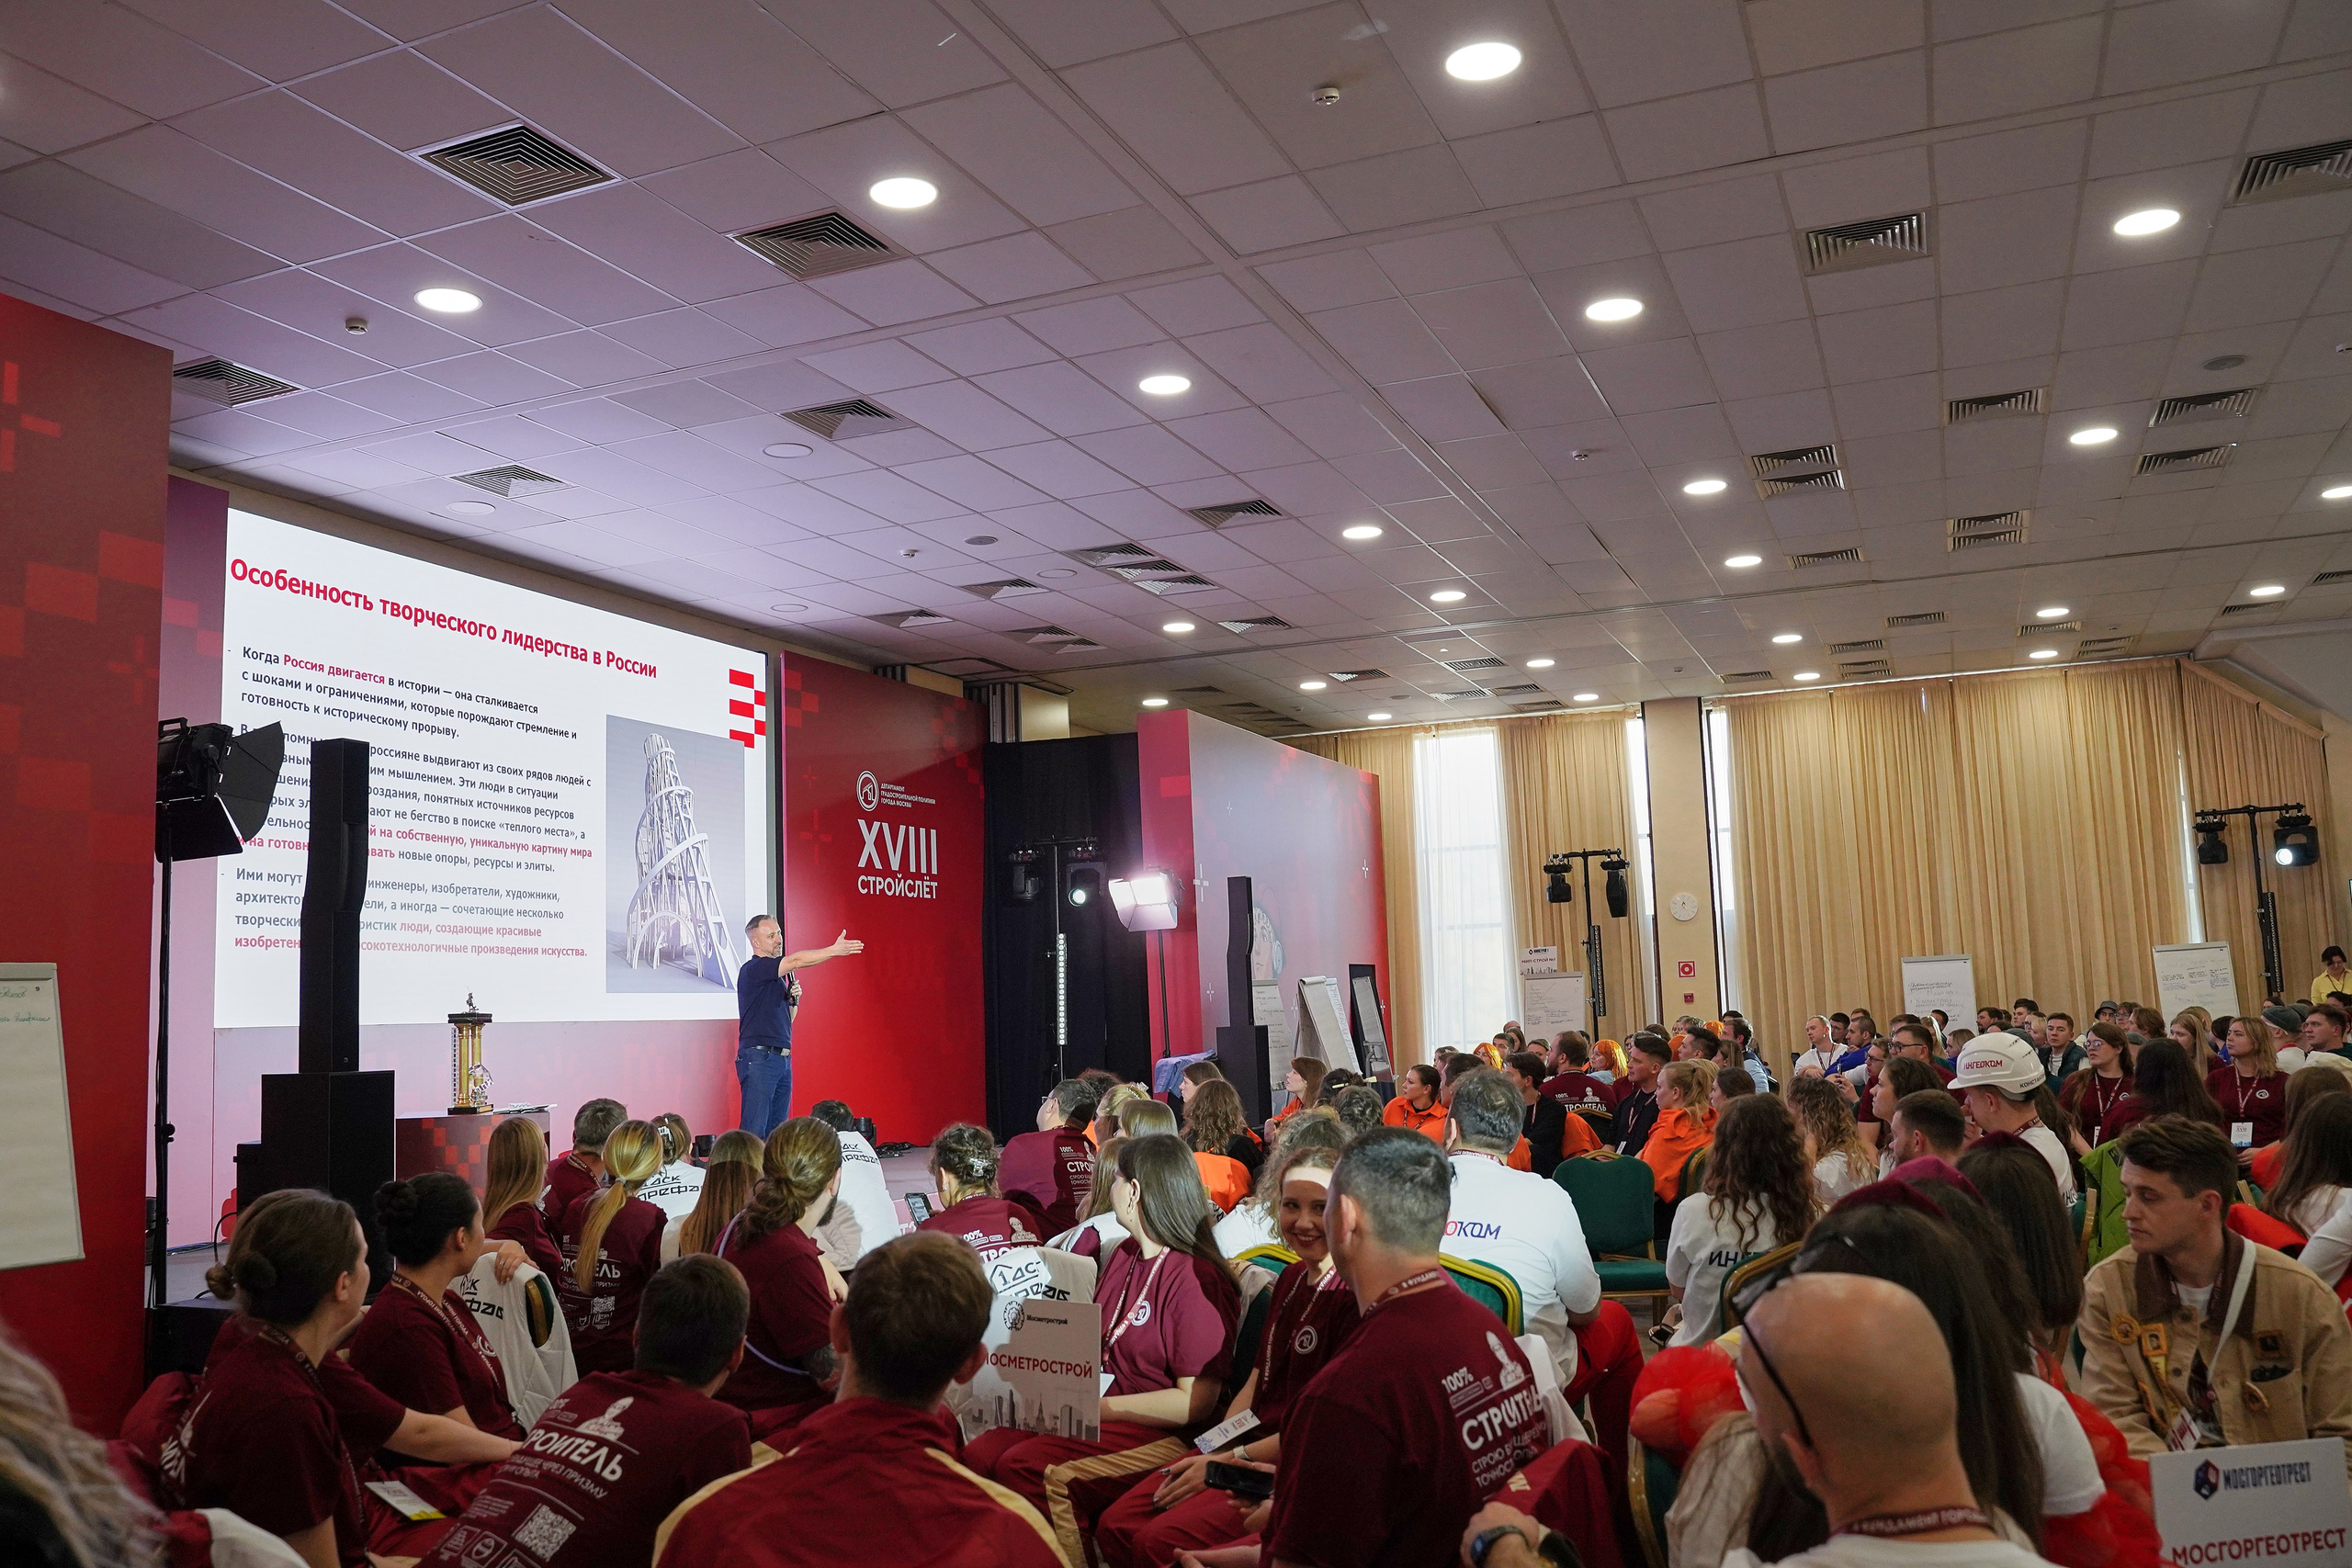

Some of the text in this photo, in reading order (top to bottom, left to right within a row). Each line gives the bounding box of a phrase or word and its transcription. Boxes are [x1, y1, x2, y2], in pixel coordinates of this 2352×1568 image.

[231, 558, 657, 678] Особенность творческого лидерства в России
[243, 647, 279, 665] Когда
[284, 654, 324, 672] Россия
[328, 666, 385, 684] двигается
[389, 678, 394, 686] в
[398, 680, 440, 694] истории
[455, 691, 472, 701] она
[475, 695, 537, 714] сталкивается
[242, 671, 248, 680] с
[252, 672, 300, 690] шоками
[306, 682, 312, 692] и
[316, 684, 407, 711] ограничениями,
[411, 702, 455, 717] которые
[458, 711, 514, 728] порождают
[516, 722, 569, 738] стремление
[242, 693, 458, 739] готовность к историческому прорыву.
[370, 747, 420, 761] россияне
[424, 754, 481, 770] выдвигают
[483, 763, 493, 772] из
[496, 765, 523, 776] своих
[526, 770, 553, 781] рядов
[555, 774, 583, 785] людей
[389, 769, 455, 785] мышлением.
[458, 776, 476, 788] Эти
[479, 782, 505, 794] люди
[508, 785, 514, 794] в
[516, 787, 558, 800] ситуации
[369, 787, 420, 803] роздания,
[424, 794, 474, 807] понятных
[477, 800, 531, 814] источников
[535, 807, 574, 820] ресурсов
[395, 810, 407, 819] не
[411, 809, 450, 824] бегство
[453, 817, 458, 825] в
[462, 818, 496, 829] поиске
[499, 822, 541, 834] «теплого
[545, 828, 578, 840] места»,
[249, 838, 264, 847] на
[268, 839, 309, 851] готовн
[399, 851, 432, 862] новые
[435, 854, 470, 867] опоры,
[474, 858, 513, 870] ресурсы
[525, 862, 555, 872] элиты.
[379, 829, 392, 838] на
[396, 829, 467, 847] собственную,
[469, 838, 529, 852] уникальную
[532, 844, 568, 857] картину
[571, 848, 592, 859] мира
[857, 818, 938, 874] XVIII
[237, 868, 560, 902] Ими могут инженеры, изобретатели, художники,
[857, 873, 938, 899] СТРОЙСЛЁТ
[236, 893, 301, 905] архитекто
[401, 902, 436, 913] иногда
[453, 906, 514, 918] сочетающие
[516, 909, 563, 919] несколько
[235, 916, 541, 938] творчески ристик люди, создающие красивые
[235, 935, 587, 958] изобретен сокотехнологичные произведения искусства.
[1565, 1102, 1607, 1111] ТРОИТЕЛЬ
[963, 1229, 983, 1242] 00%
[1444, 1221, 1501, 1239] ОКОМ
[1026, 1314, 1069, 1325] Мосметрострой
[1442, 1366, 1475, 1393] 100%
[522, 1427, 623, 1482] РОИТЕЛЬ
[562, 1467, 608, 1499] ПРИЗМУ
[2222, 1461, 2311, 1491] МОСГОРГЕОТРЕСТ
[2171, 1528, 2346, 1565] МОСГОРГЕОТРЕСТ
